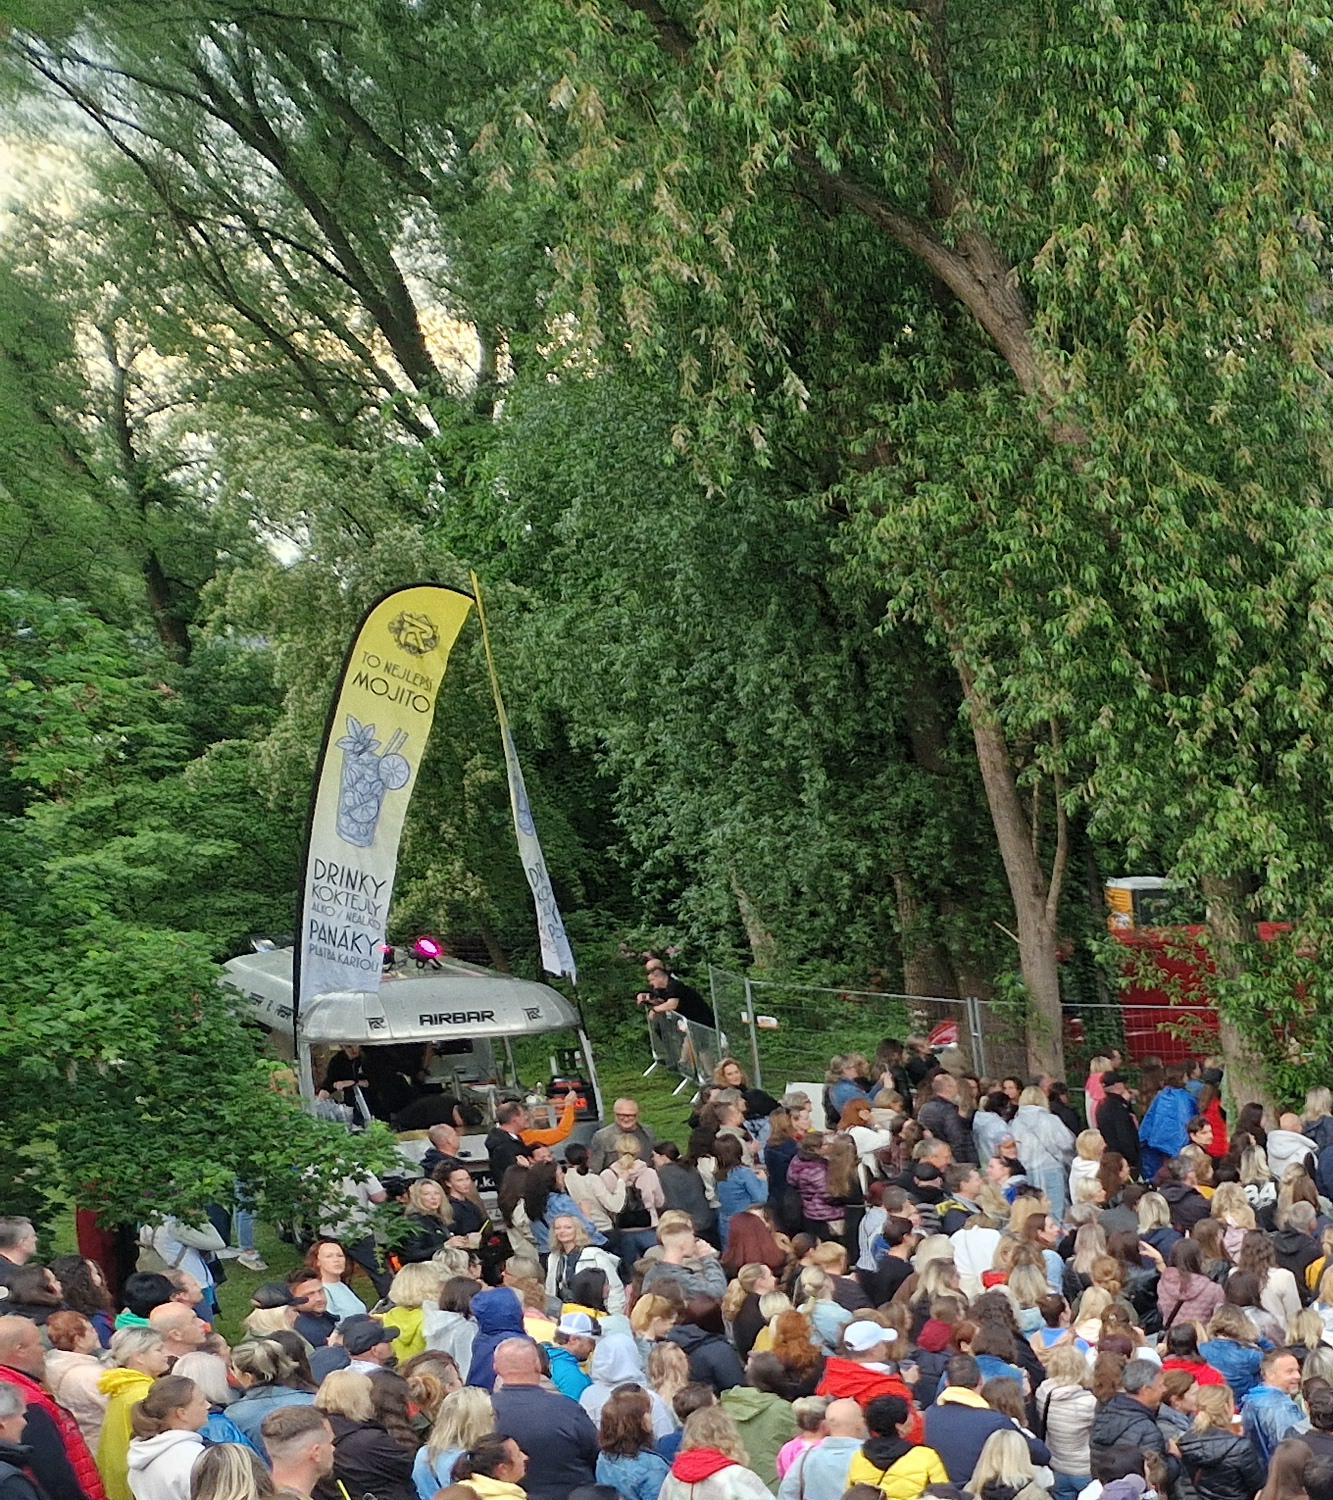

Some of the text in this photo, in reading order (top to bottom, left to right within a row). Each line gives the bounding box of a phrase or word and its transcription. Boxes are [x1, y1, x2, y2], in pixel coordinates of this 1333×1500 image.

[362, 651, 381, 668] TO
[352, 670, 431, 713] MOJITO
[314, 858, 387, 899] DRINKY
[312, 883, 382, 917] KOKTEJLY
[312, 902, 336, 917] ALKO
[346, 911, 381, 930] NEALKO
[310, 918, 380, 957] PANÁKY
[309, 943, 379, 973] PLATBA KARTOU
[418, 1010, 497, 1026] AIRBAR
